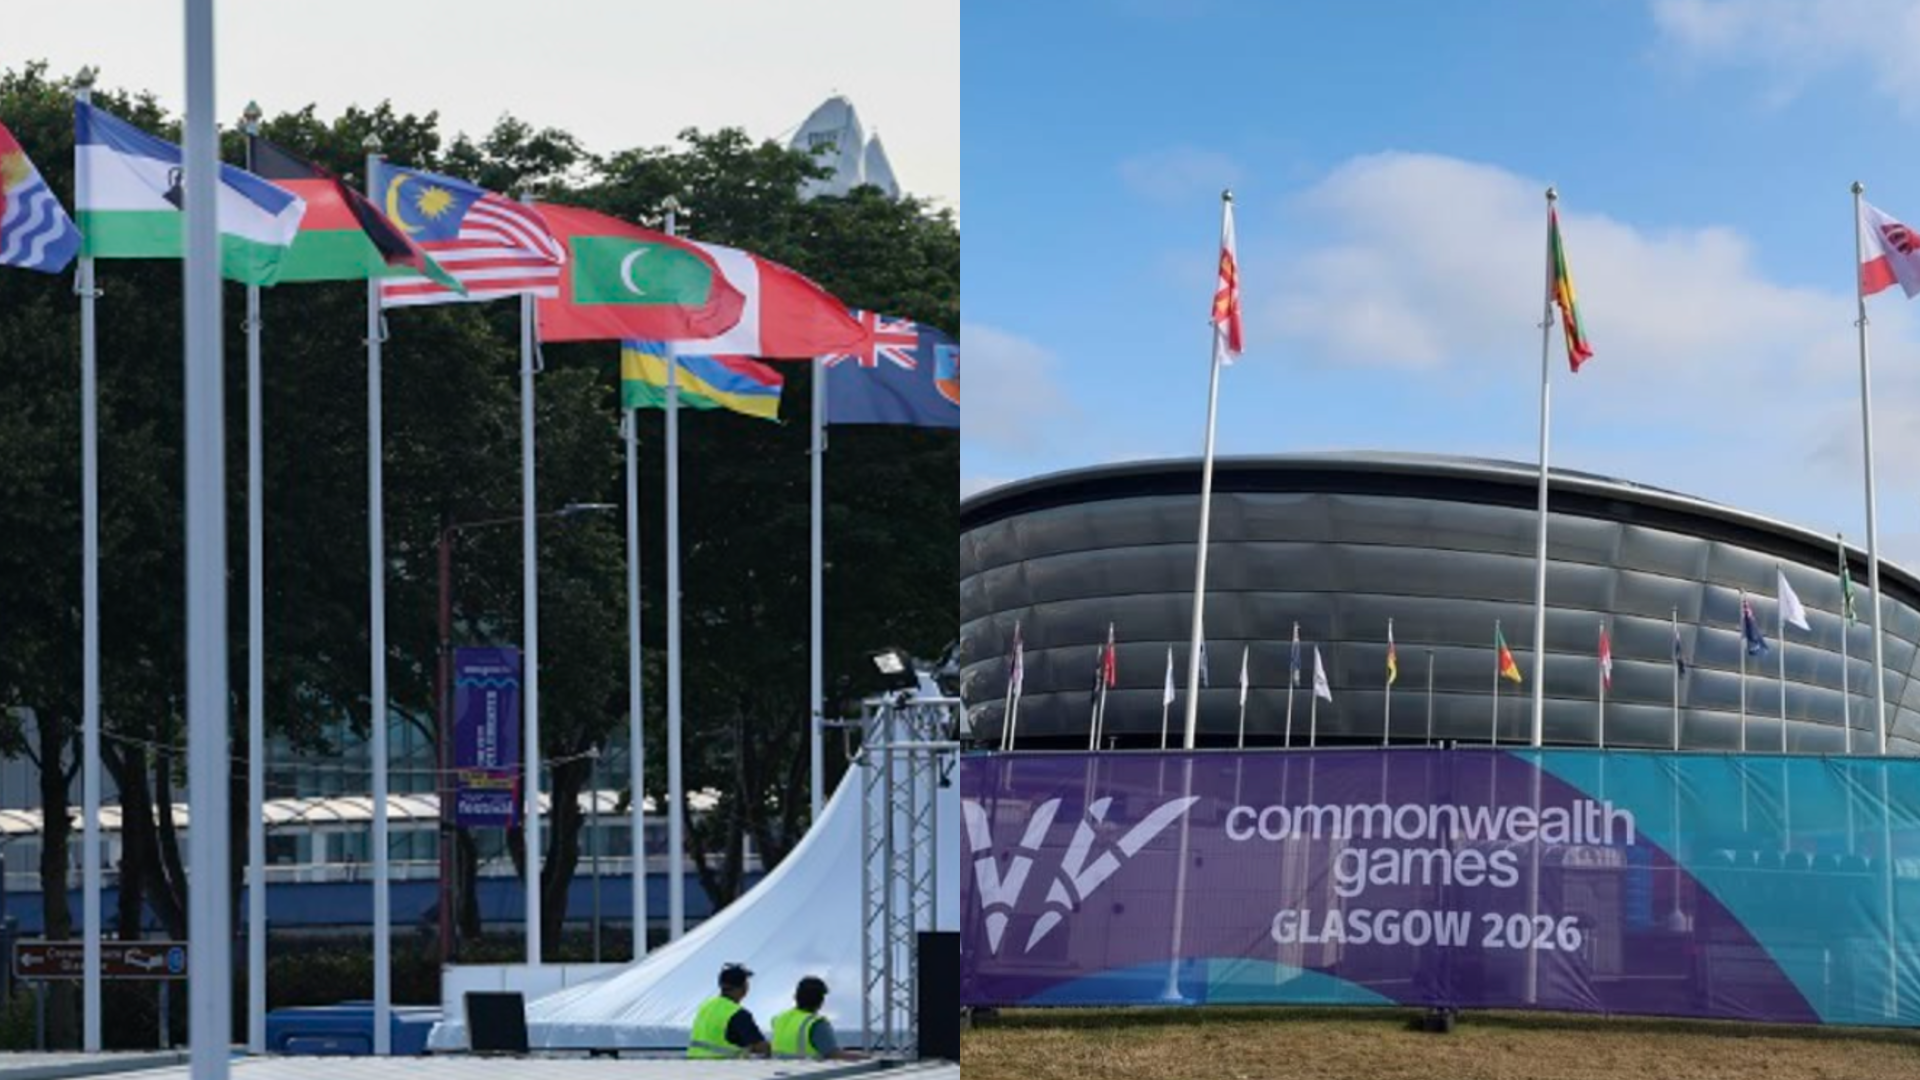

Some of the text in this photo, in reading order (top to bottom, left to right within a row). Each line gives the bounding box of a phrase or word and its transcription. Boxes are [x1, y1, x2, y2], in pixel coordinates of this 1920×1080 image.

[1226, 800, 1635, 845] commonwealth
[1333, 847, 1519, 897] games
[1271, 909, 1582, 951] GLASGOW 2026
